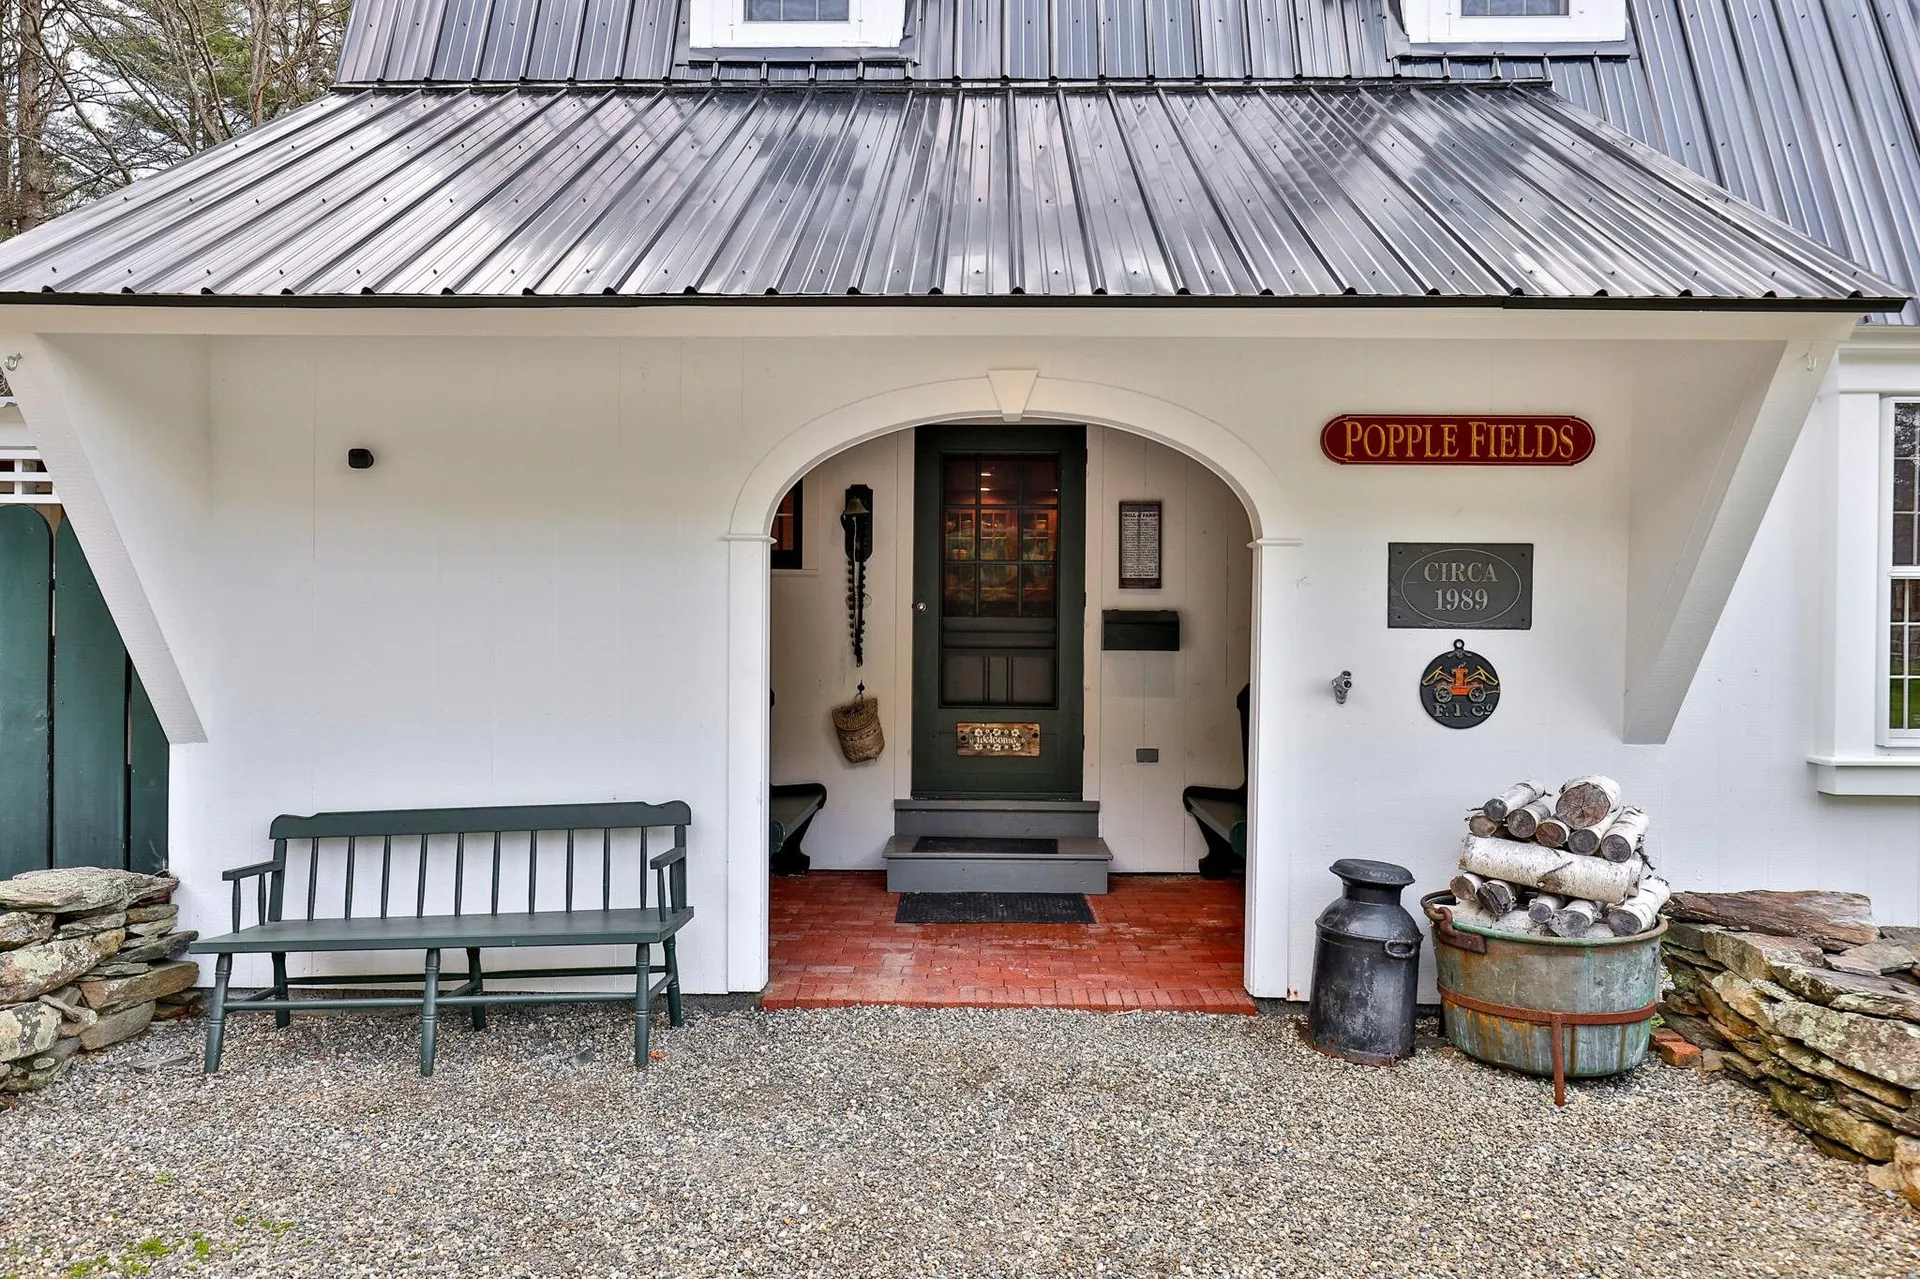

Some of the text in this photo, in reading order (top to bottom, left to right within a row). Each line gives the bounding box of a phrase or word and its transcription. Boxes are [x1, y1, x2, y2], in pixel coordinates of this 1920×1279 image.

[1344, 421, 1574, 459] POPPLE FIELDS
[1424, 562, 1499, 582] CIRCA
[1434, 588, 1489, 611] 1989
